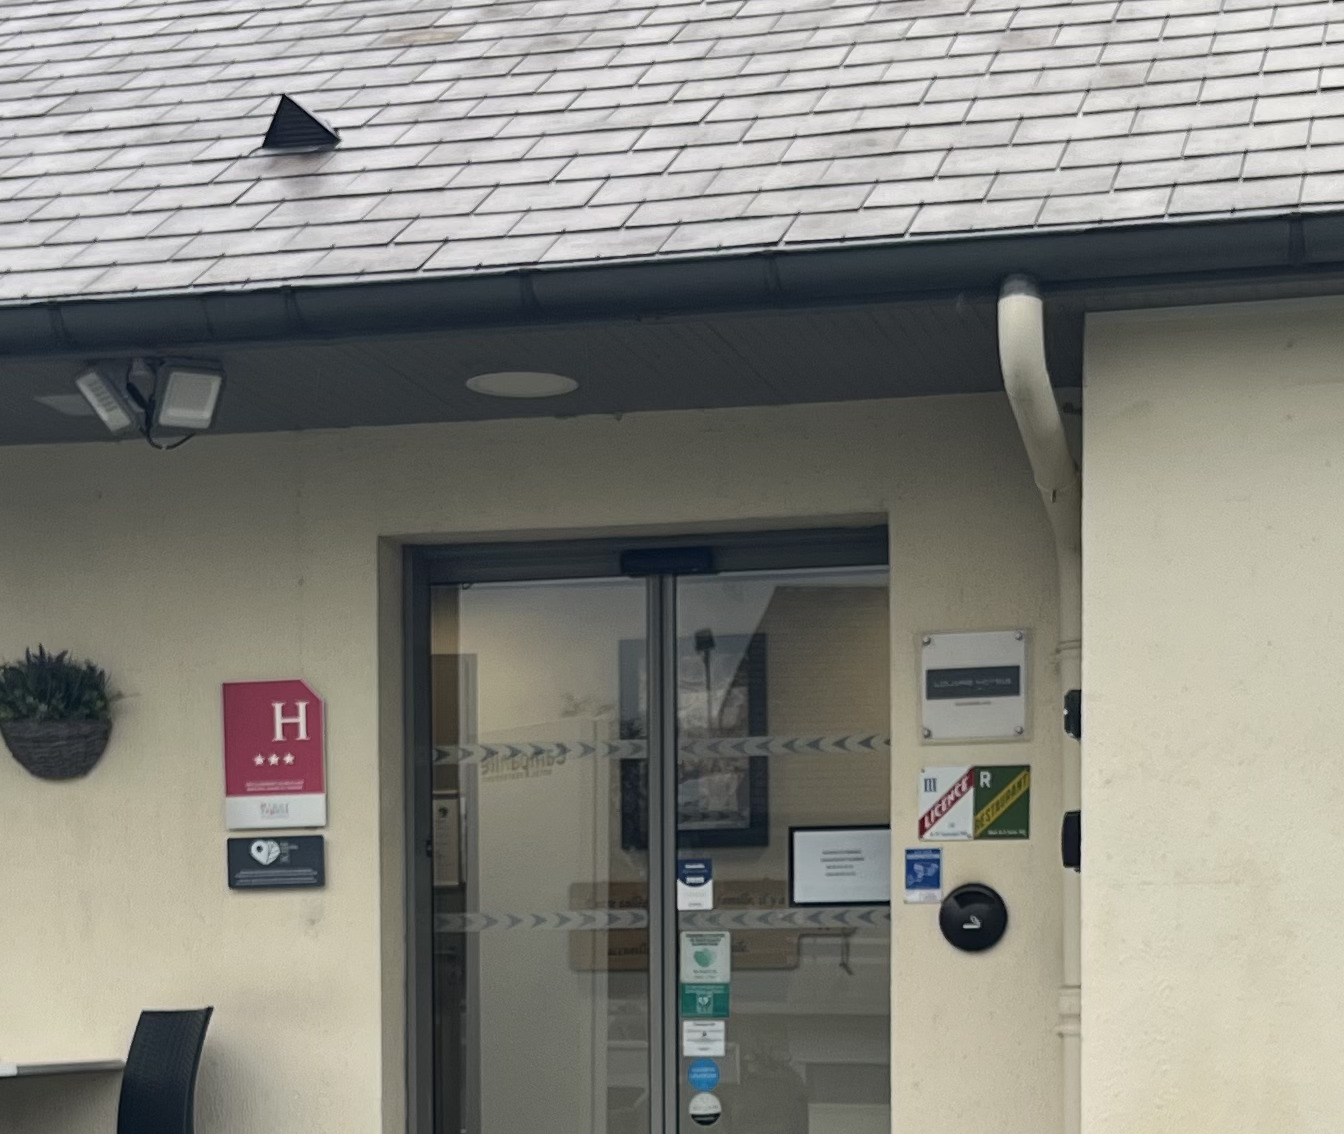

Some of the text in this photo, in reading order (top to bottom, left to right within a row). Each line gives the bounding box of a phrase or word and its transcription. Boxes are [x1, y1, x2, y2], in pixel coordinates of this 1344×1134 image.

[271, 701, 311, 742] H
[979, 771, 992, 788] R
[924, 775, 969, 829] LICENCE
